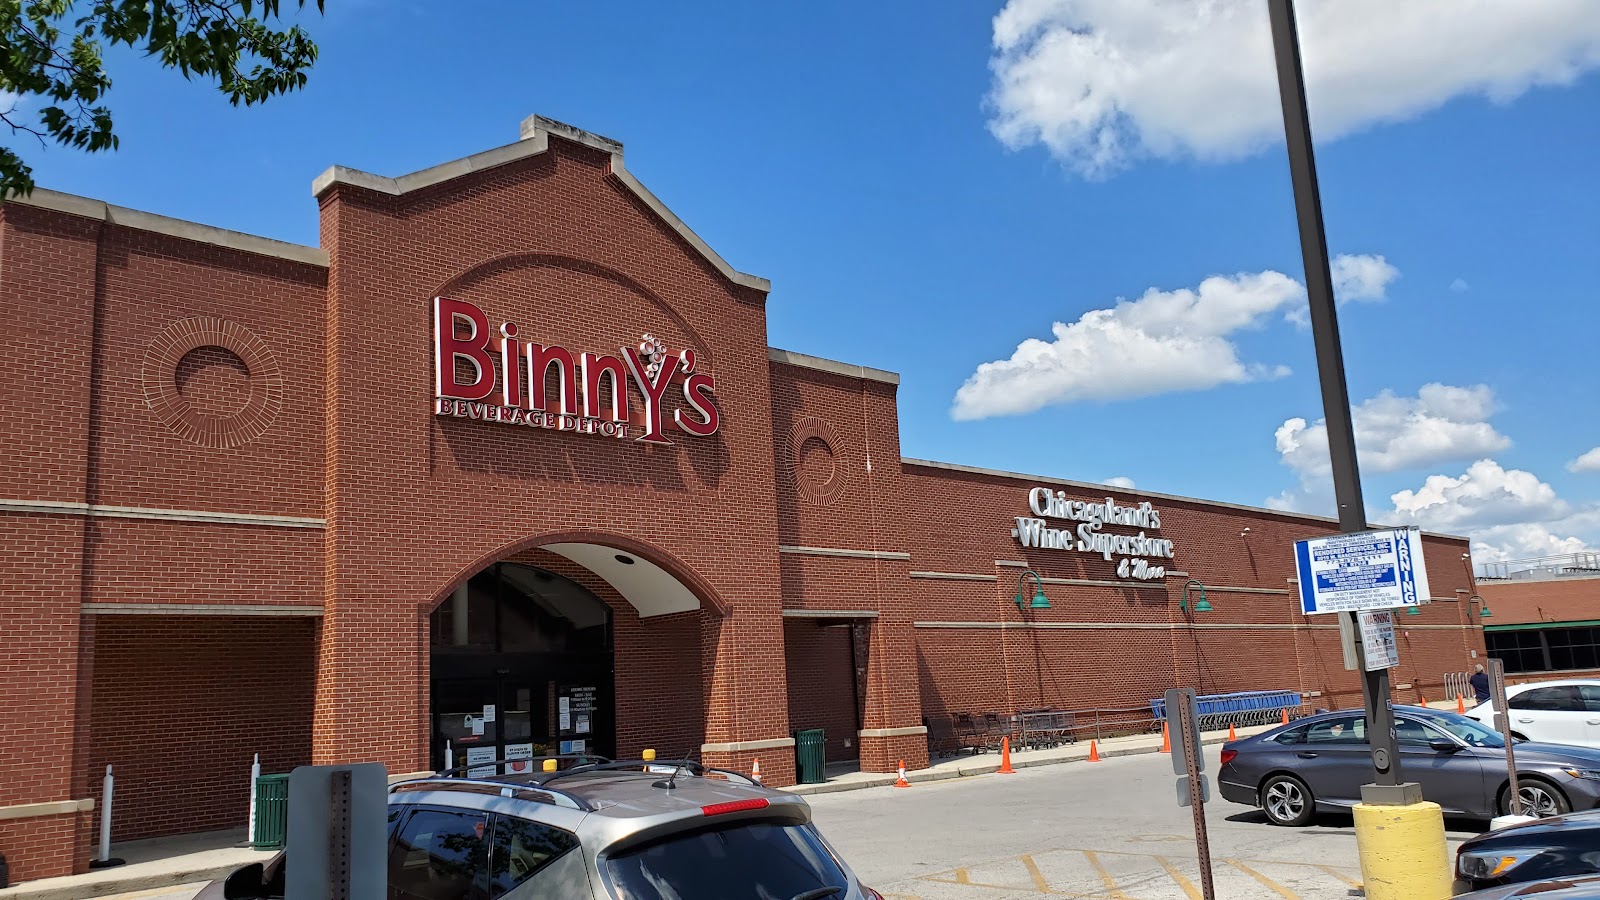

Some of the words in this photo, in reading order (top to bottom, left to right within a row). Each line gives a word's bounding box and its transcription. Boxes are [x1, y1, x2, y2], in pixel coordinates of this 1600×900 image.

[435, 398, 555, 429] BEVERAGE
[559, 415, 629, 438] DEPOT
[1029, 487, 1161, 530] Chicagoland's
[1014, 516, 1073, 551] Wine
[1077, 523, 1175, 561] Superstore
[1314, 548, 1345, 556] RENDERED
[1117, 558, 1129, 578] &
[1130, 558, 1166, 580] More
[1394, 530, 1416, 603] WARNING
[1363, 613, 1390, 625] WARNING
